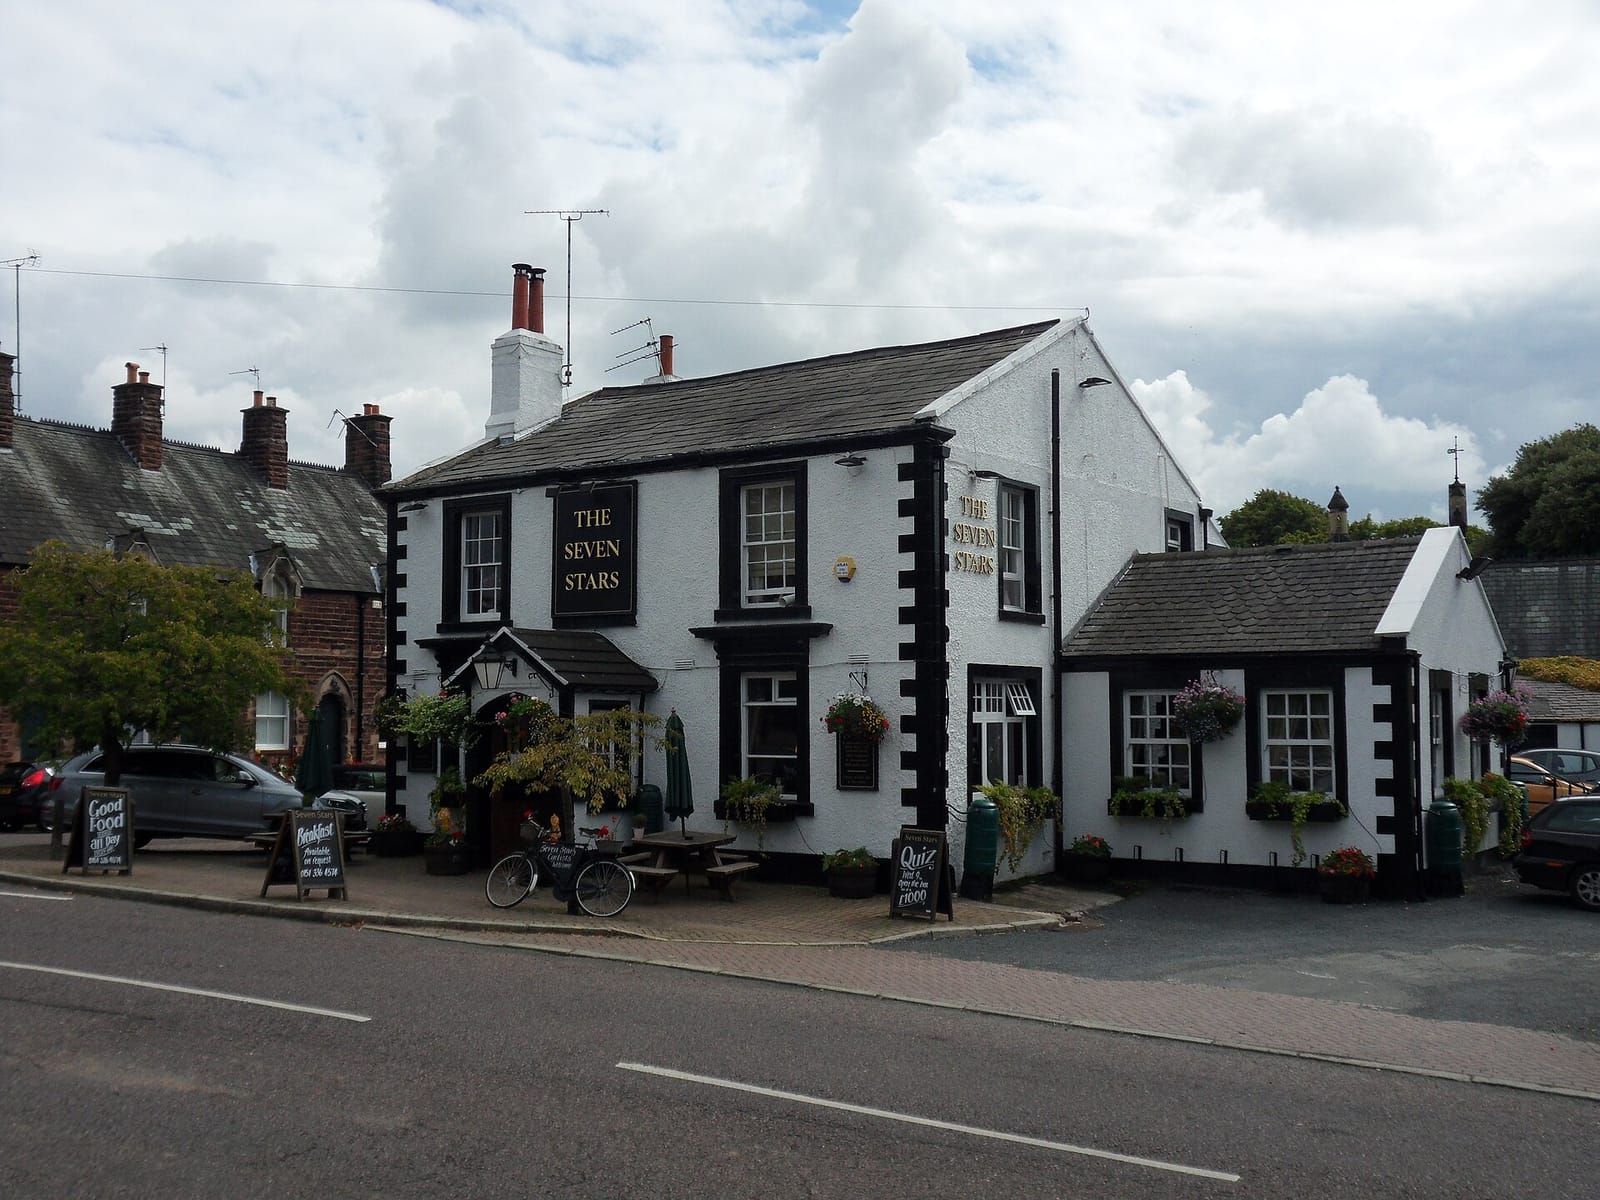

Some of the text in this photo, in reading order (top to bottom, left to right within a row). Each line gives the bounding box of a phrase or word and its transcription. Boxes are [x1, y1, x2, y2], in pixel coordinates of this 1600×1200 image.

[574, 508, 611, 528] THE
[960, 496, 989, 520] THE
[954, 523, 995, 548] SEVEN
[564, 540, 620, 560] SEVEN
[956, 550, 994, 575] STARS
[565, 571, 619, 591] STARS
[88, 798, 123, 818] Good
[317, 811, 334, 819] Stars
[89, 812, 124, 832] Food
[297, 823, 334, 847] Breakfast
[901, 846, 937, 870] Quiz
